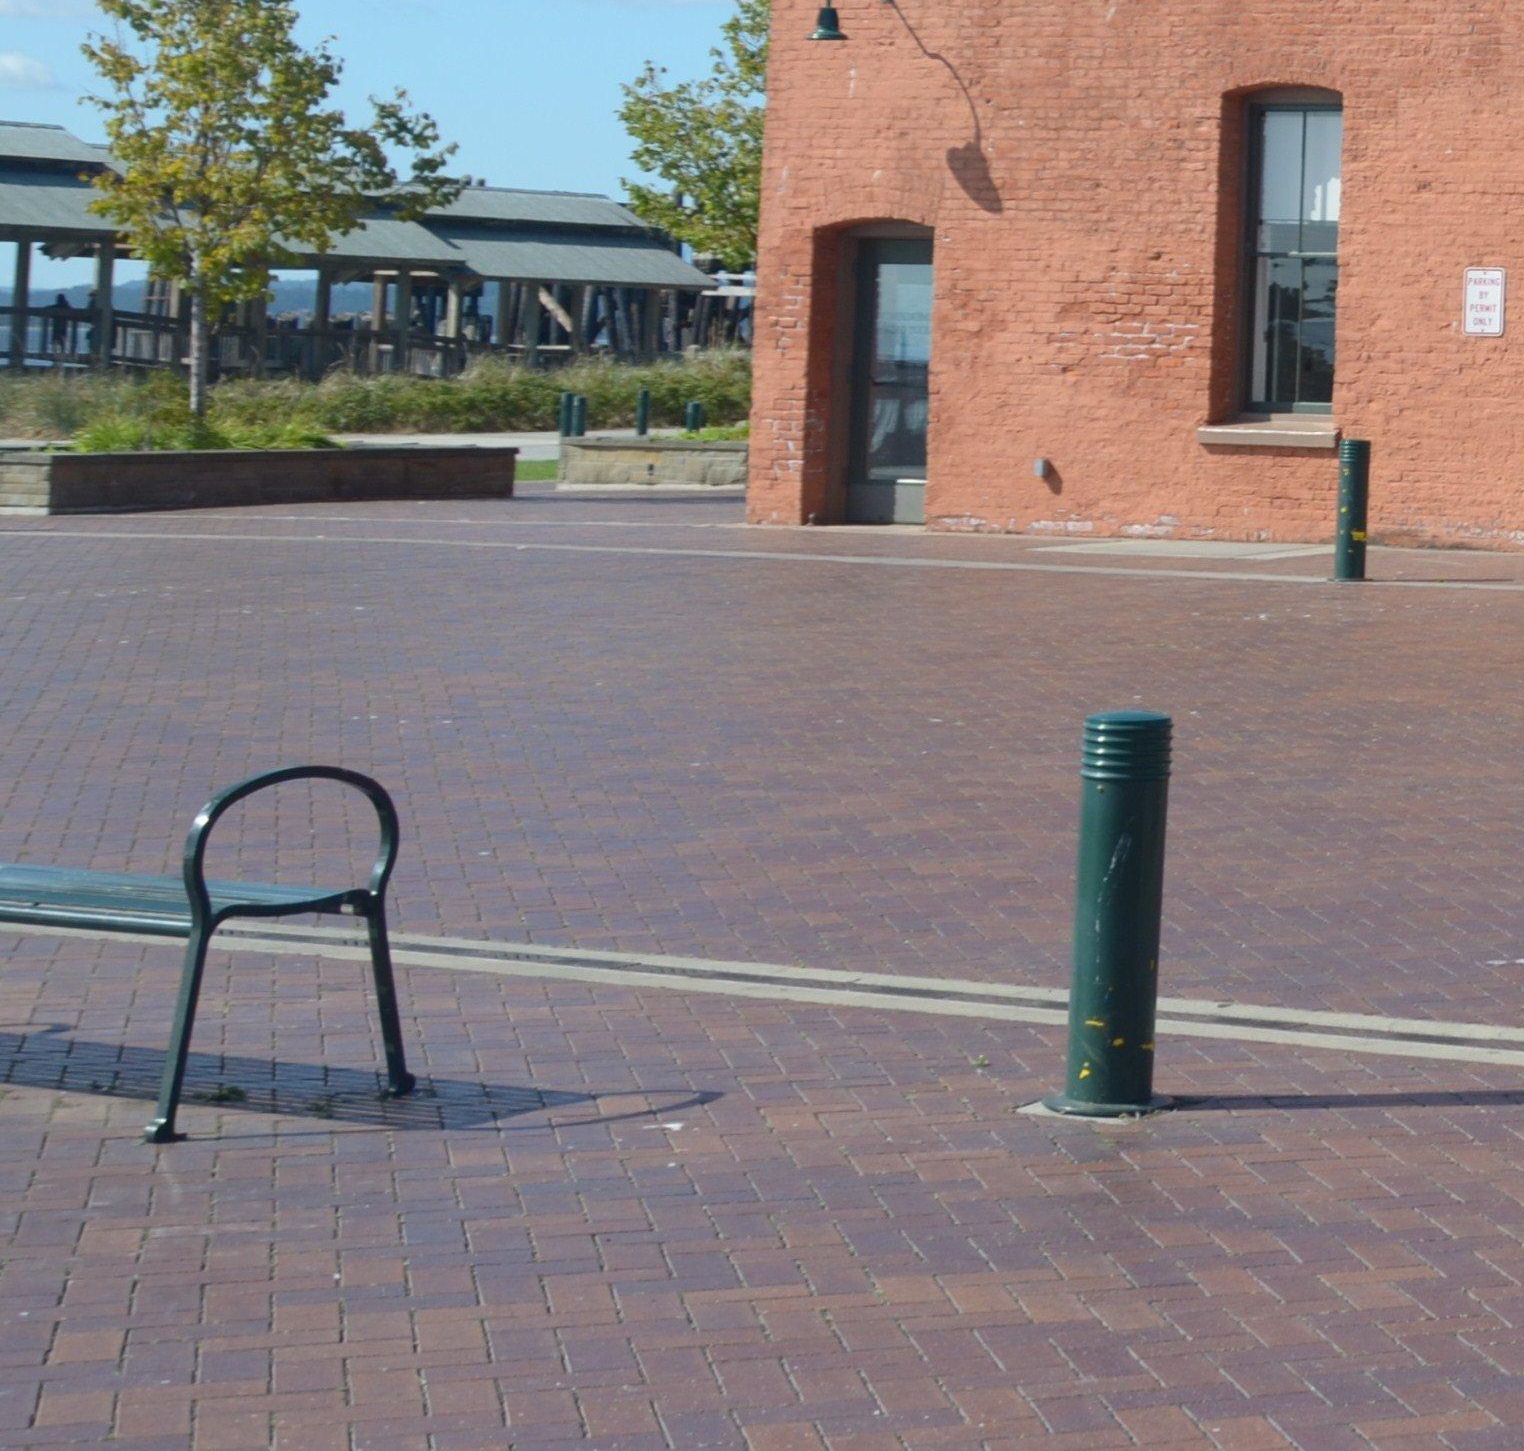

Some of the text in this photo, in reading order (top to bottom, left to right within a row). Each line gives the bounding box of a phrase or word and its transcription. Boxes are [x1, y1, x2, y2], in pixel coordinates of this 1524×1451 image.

[1468, 278, 1500, 286] PARKING
[1479, 291, 1489, 299] BY
[1470, 304, 1496, 312] PERMIT
[1473, 317, 1492, 325] ONLY
